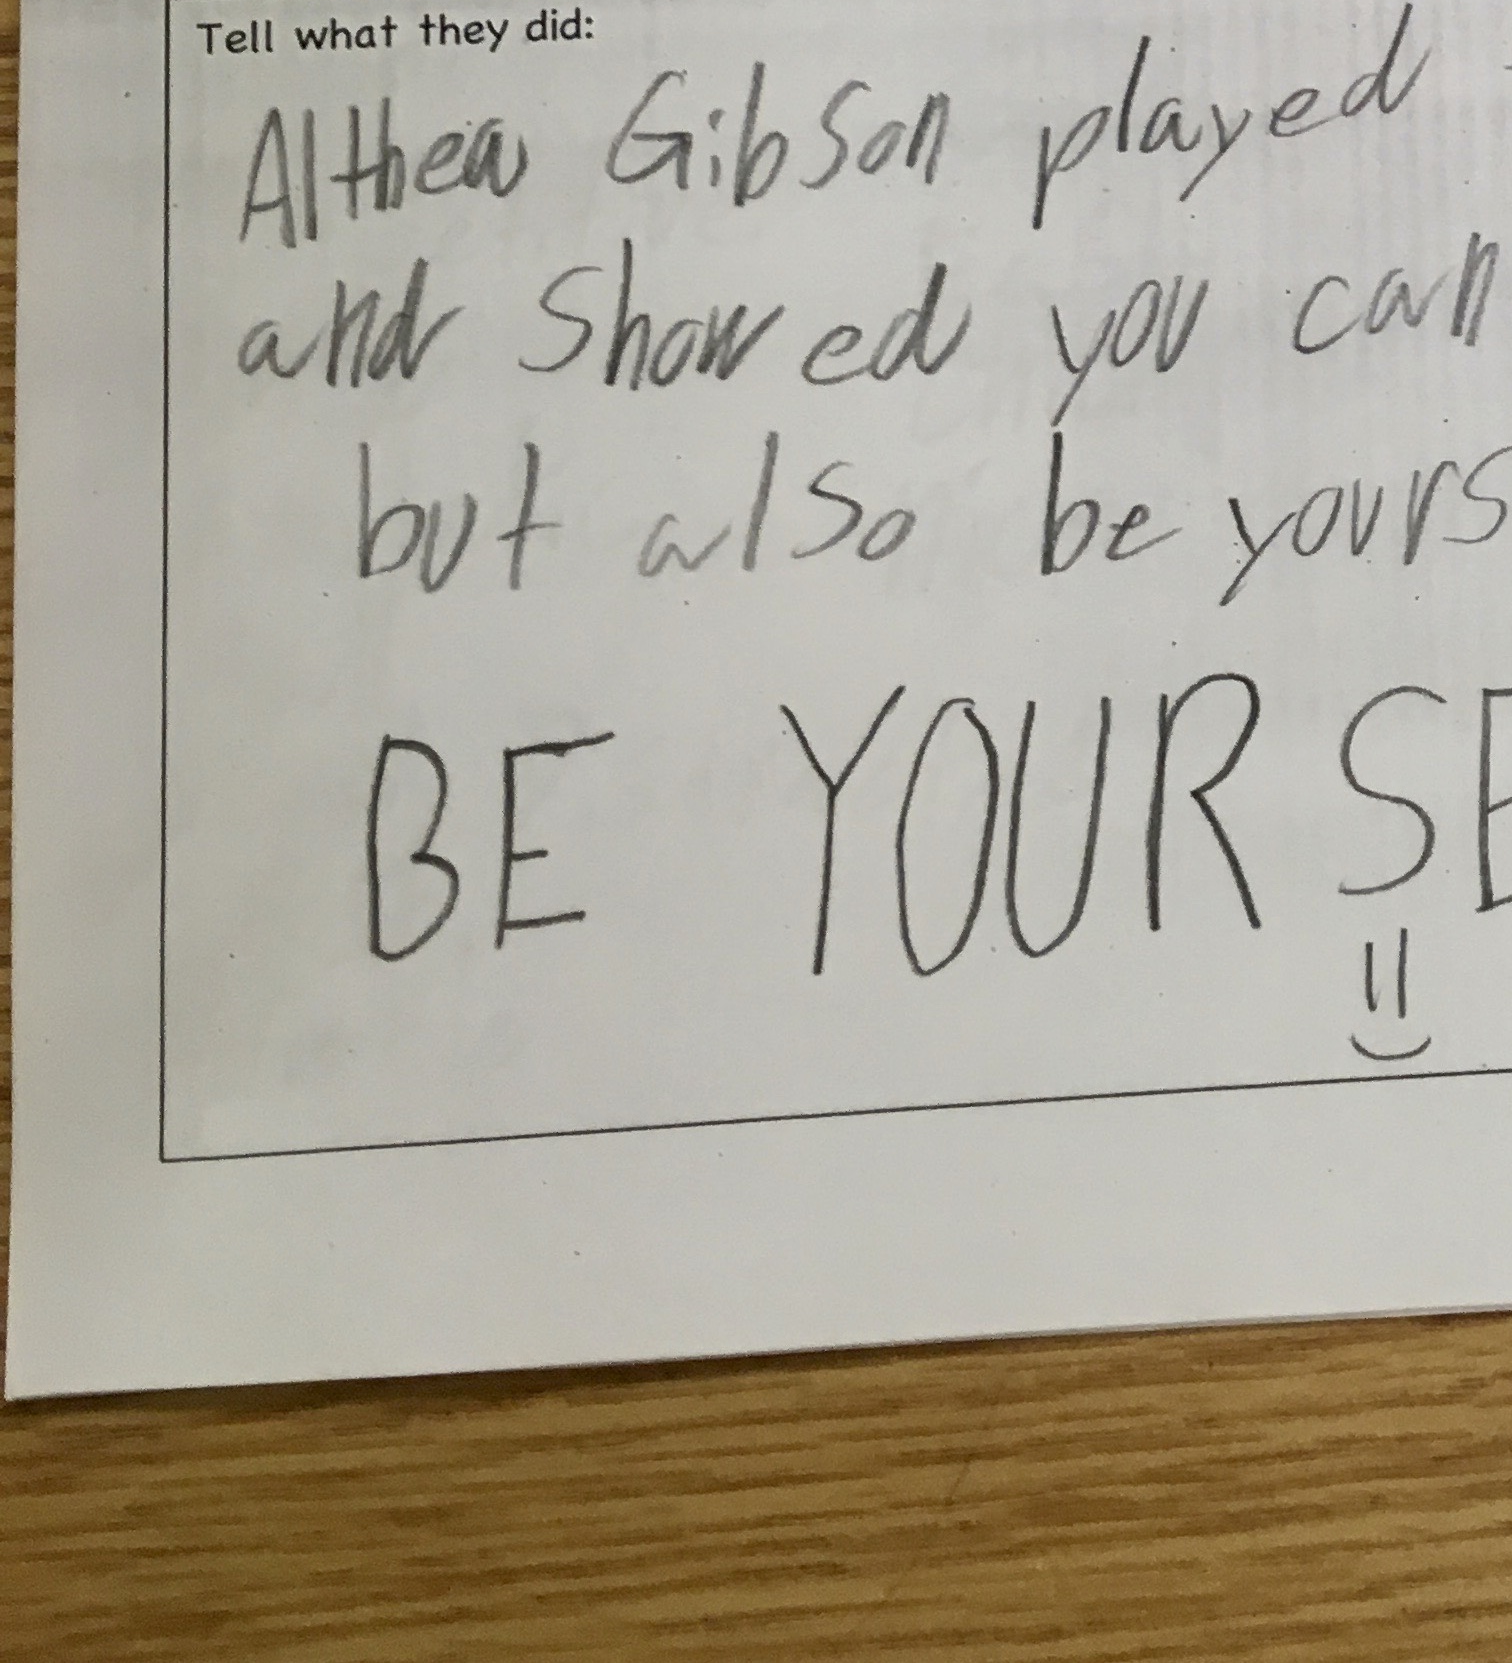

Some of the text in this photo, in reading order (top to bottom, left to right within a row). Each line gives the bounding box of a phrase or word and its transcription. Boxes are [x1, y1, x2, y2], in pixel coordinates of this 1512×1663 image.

[198, 10, 595, 56] Tell what they did:
[240, 96, 528, 248] Althea
[1032, 2, 1428, 230] played
[238, 256, 466, 390] and
[1050, 274, 1210, 428] you
[1292, 232, 1500, 354] can
[358, 440, 562, 592] but
[1040, 432, 1184, 576] be
[366, 732, 614, 960] BE
